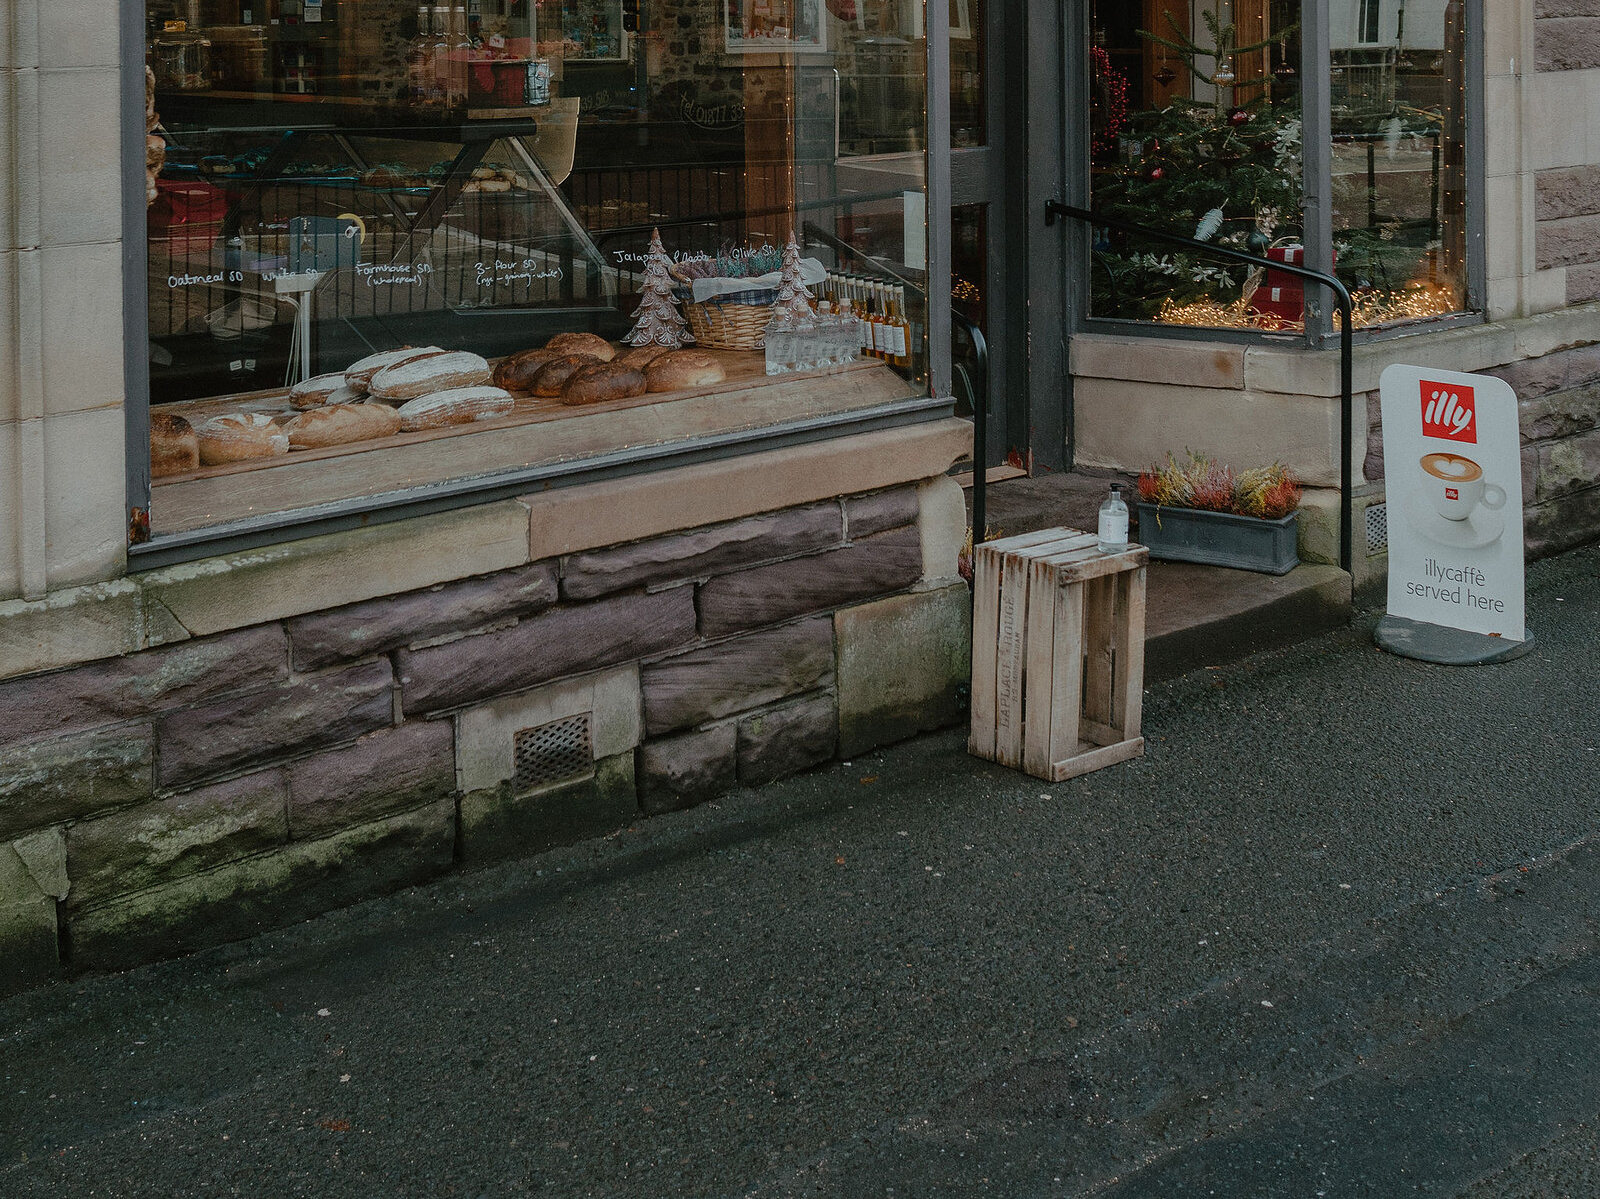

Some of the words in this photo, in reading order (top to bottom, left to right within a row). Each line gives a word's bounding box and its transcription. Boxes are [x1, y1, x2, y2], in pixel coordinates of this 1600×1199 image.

[696, 105, 727, 125] 01877
[732, 248, 757, 259] Olive
[355, 261, 411, 275] Farmhouse
[168, 271, 224, 288] Oatmeal
[1424, 390, 1473, 435] illy
[1425, 558, 1486, 587] illycaffè
[1406, 581, 1461, 605] served
[1467, 588, 1505, 613] here
